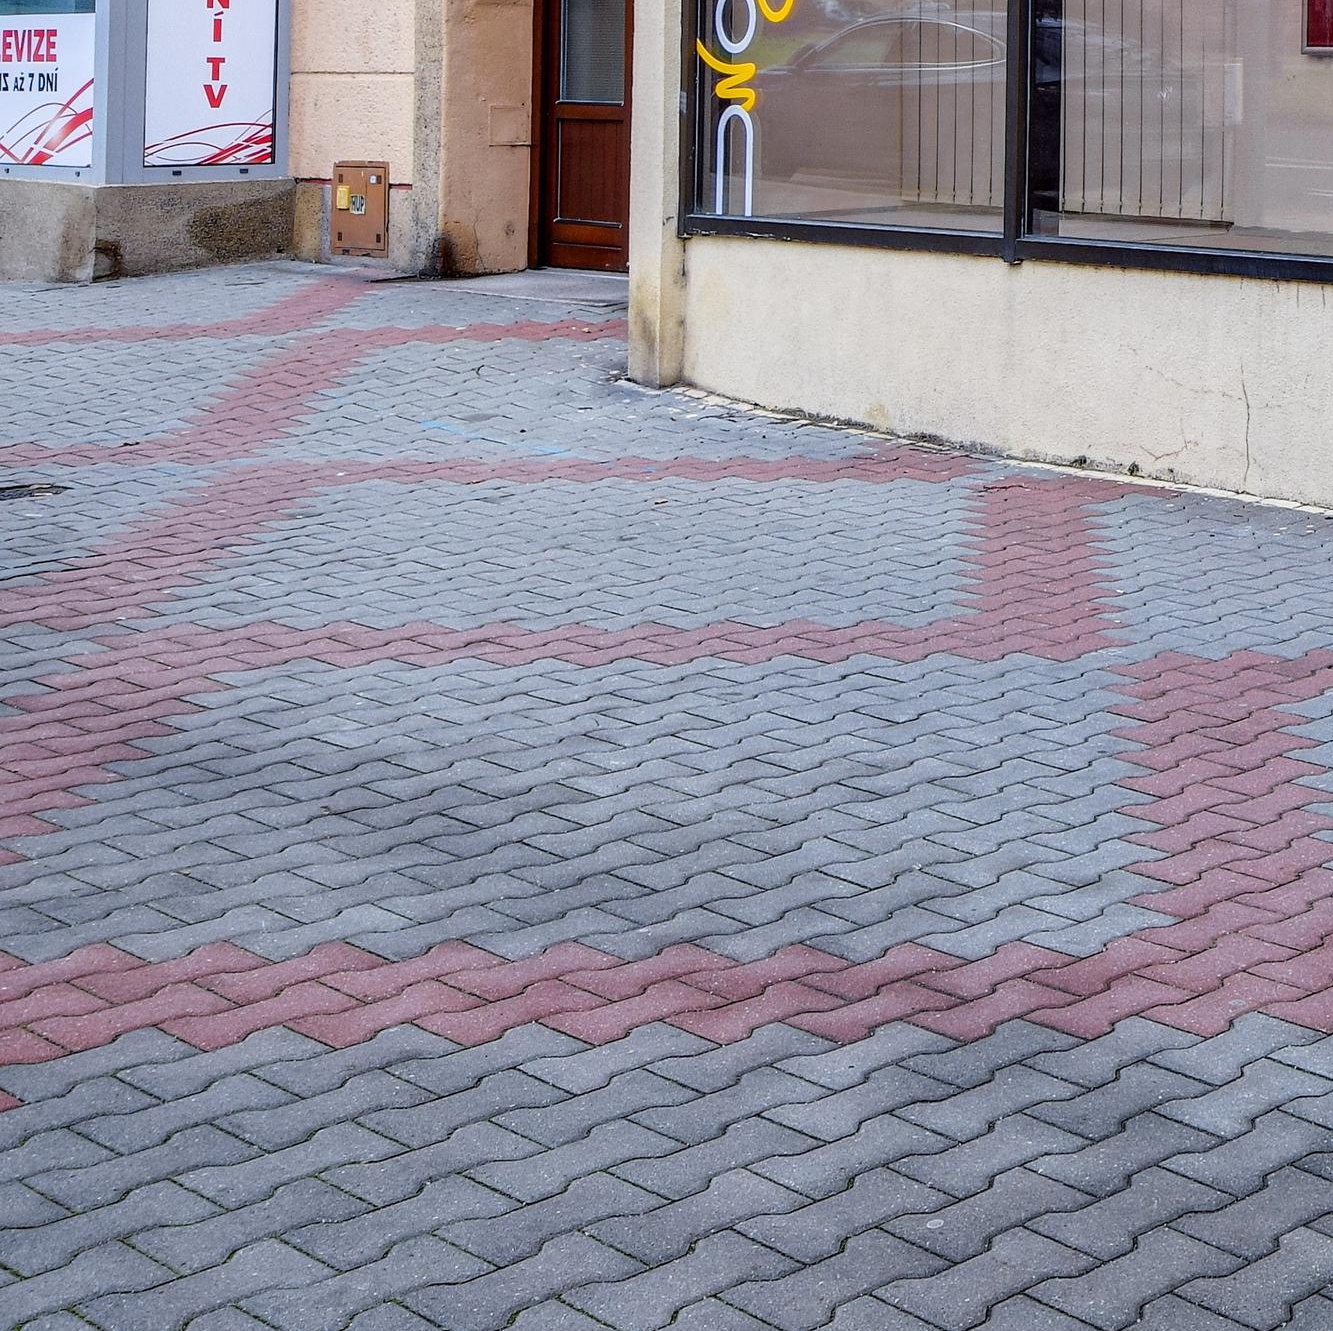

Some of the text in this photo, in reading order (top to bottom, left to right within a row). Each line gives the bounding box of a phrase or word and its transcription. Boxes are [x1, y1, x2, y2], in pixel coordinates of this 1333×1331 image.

[0, 29, 58, 63] EVIZE
[28, 72, 35, 92] 7
[38, 67, 59, 92] DNÍ
[203, 56, 228, 108] TV
